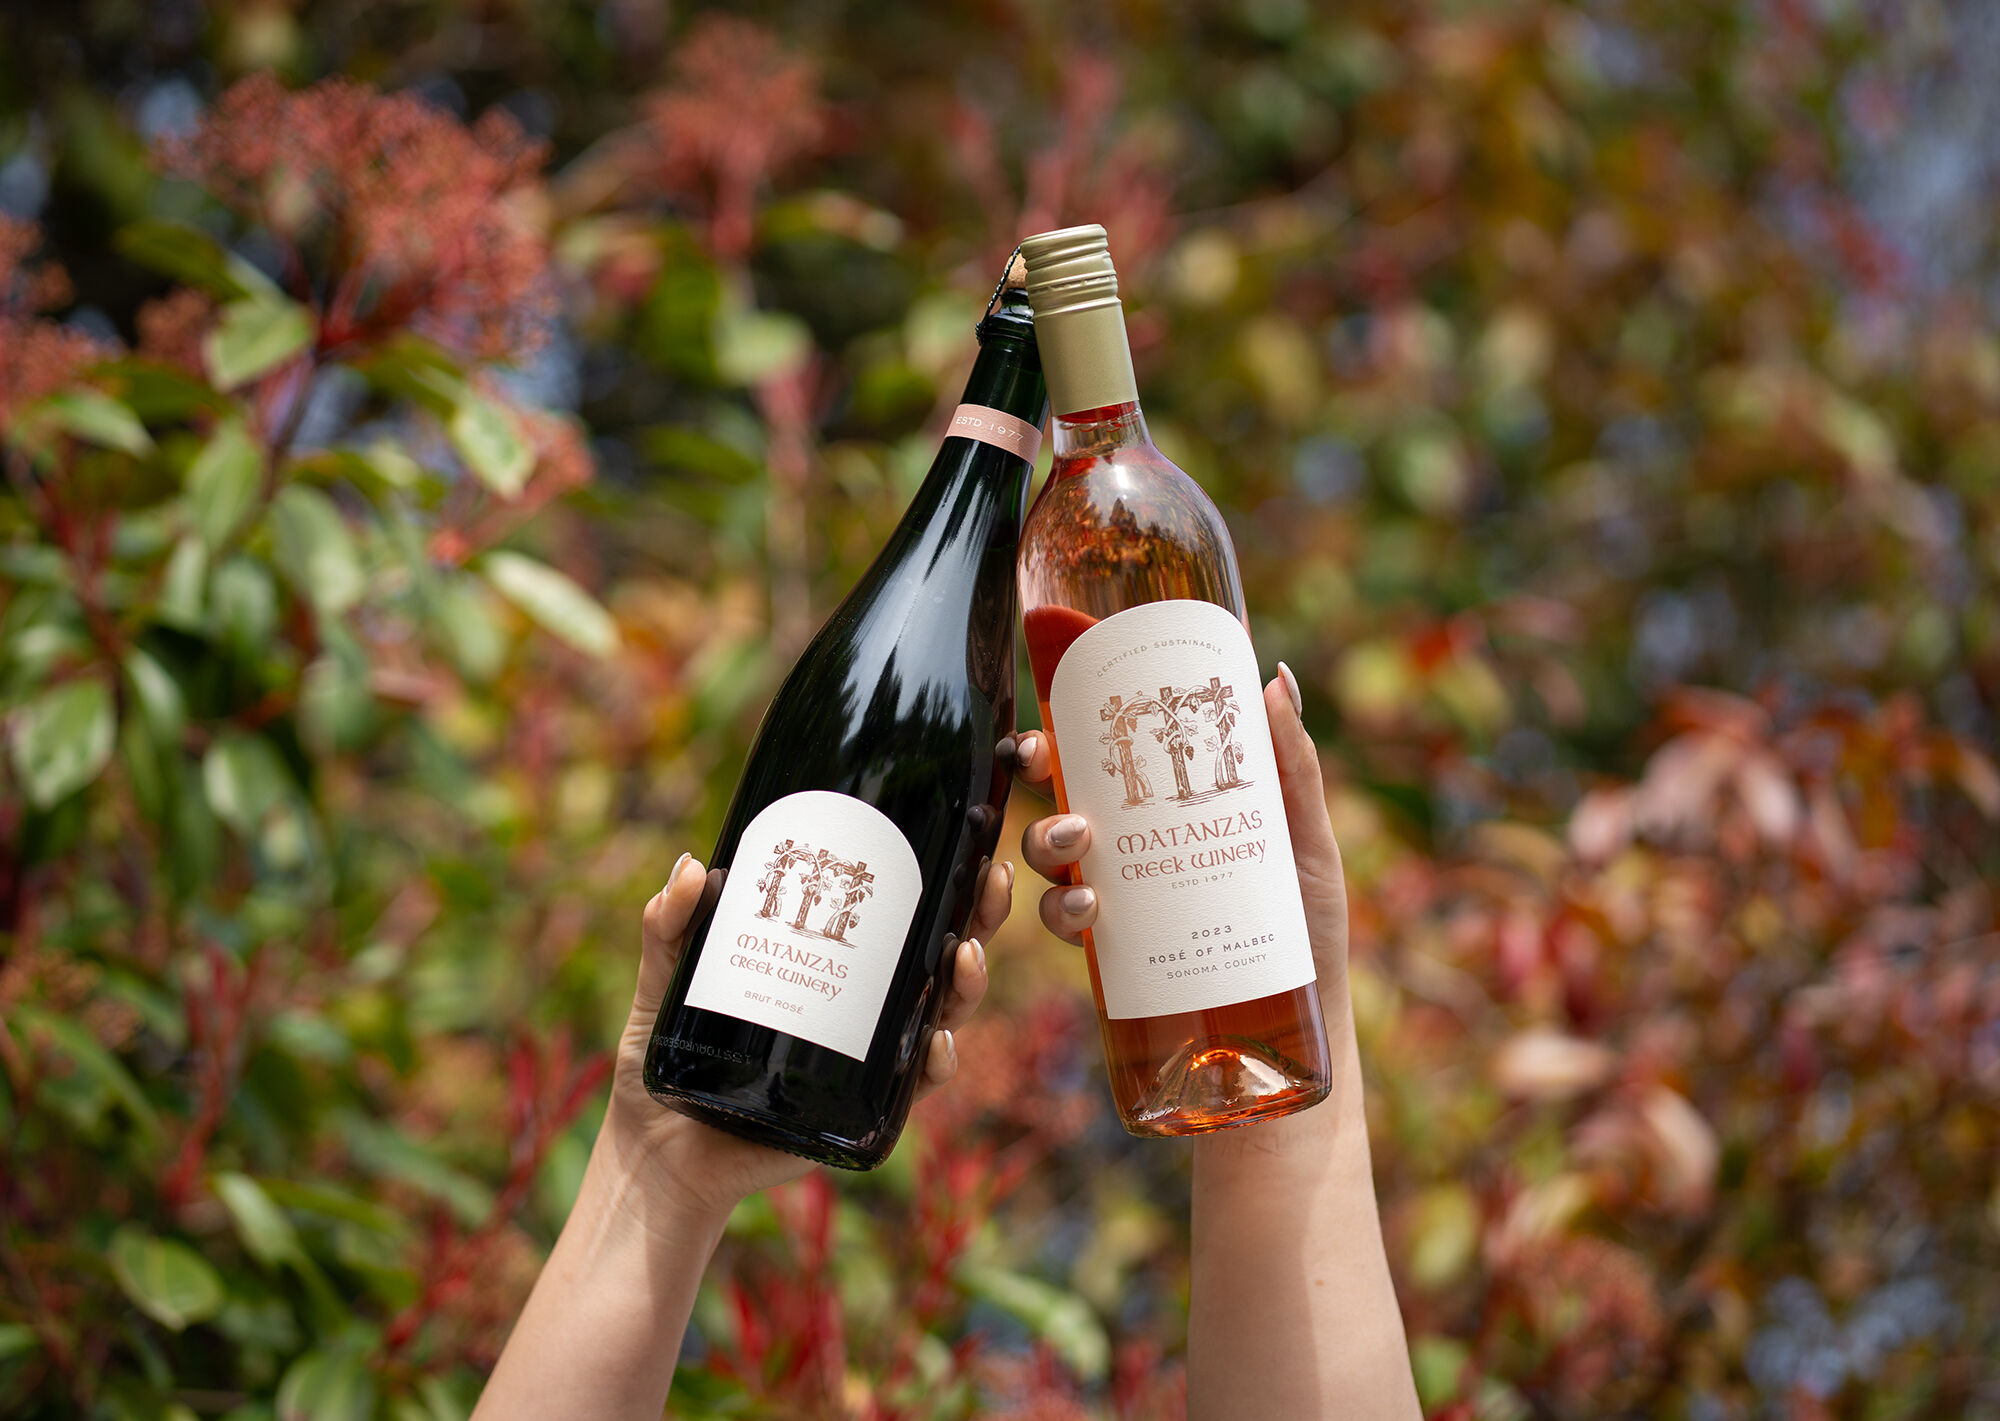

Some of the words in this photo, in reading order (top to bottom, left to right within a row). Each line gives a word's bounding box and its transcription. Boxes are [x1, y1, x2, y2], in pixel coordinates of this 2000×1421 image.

[955, 416, 983, 428] ESTD
[989, 423, 1025, 442] 1977
[1096, 644, 1148, 678] CERTIFIED
[1153, 639, 1223, 656] SUSTAINABLE
[1116, 809, 1263, 855] MATANZAS
[1121, 855, 1186, 881] CREEK
[1190, 838, 1266, 870] WINERY
[1171, 877, 1199, 890] ESTD
[1205, 871, 1234, 883] 1977
[1191, 924, 1232, 940] 2023
[737, 933, 849, 980] MATANZAS
[1149, 949, 1187, 965] ROSÉ
[1195, 946, 1213, 958] OF
[1223, 933, 1275, 953] MALBEC
[729, 953, 774, 977] CREEK
[776, 967, 842, 1002] WINERY
[1166, 964, 1219, 980] SONOMA
[1224, 953, 1267, 970] COUNTY
[743, 990, 772, 1005] BRUT
[774, 999, 805, 1016] ROSÉ
